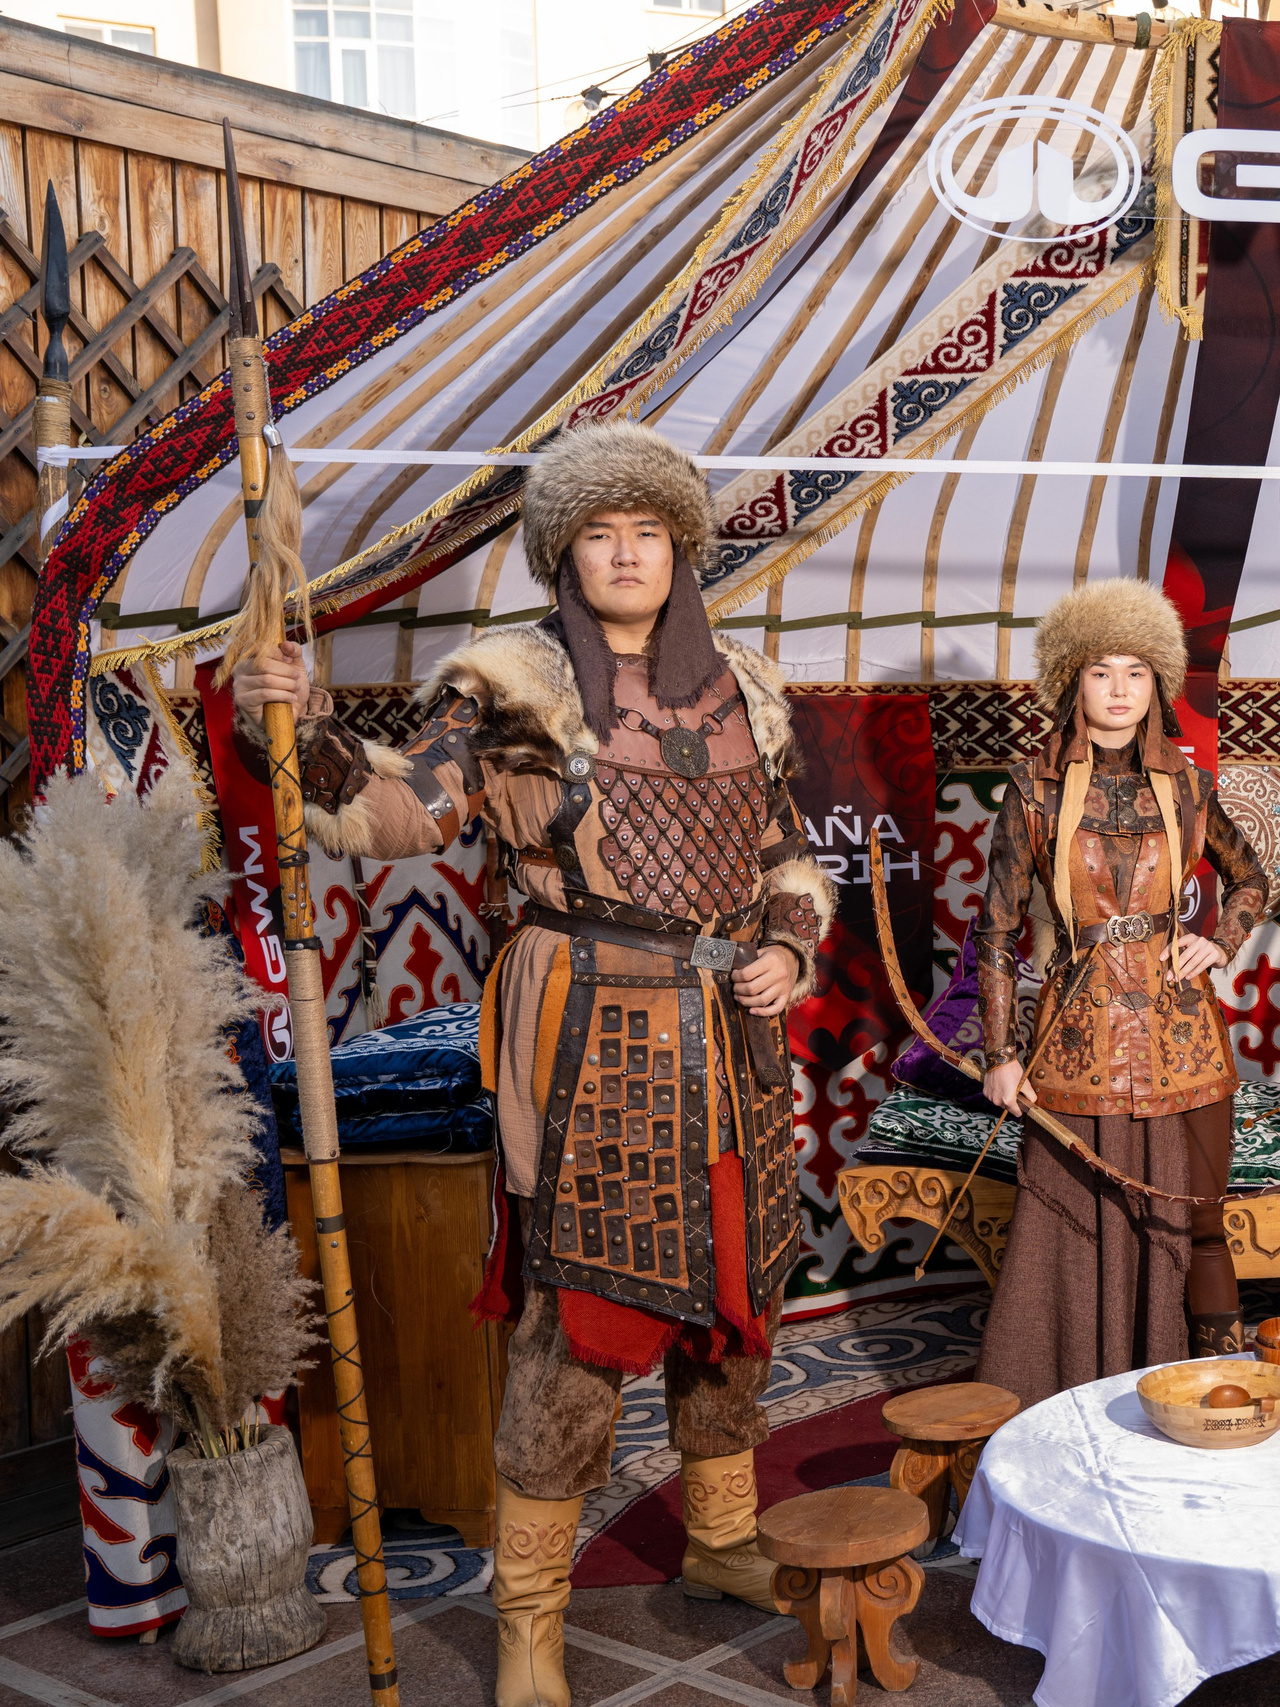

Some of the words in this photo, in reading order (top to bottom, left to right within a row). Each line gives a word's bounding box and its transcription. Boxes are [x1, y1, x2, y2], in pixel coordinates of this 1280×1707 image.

[805, 805, 906, 847] AÑA
[815, 850, 920, 885] RIH
[238, 825, 287, 984] GWM
